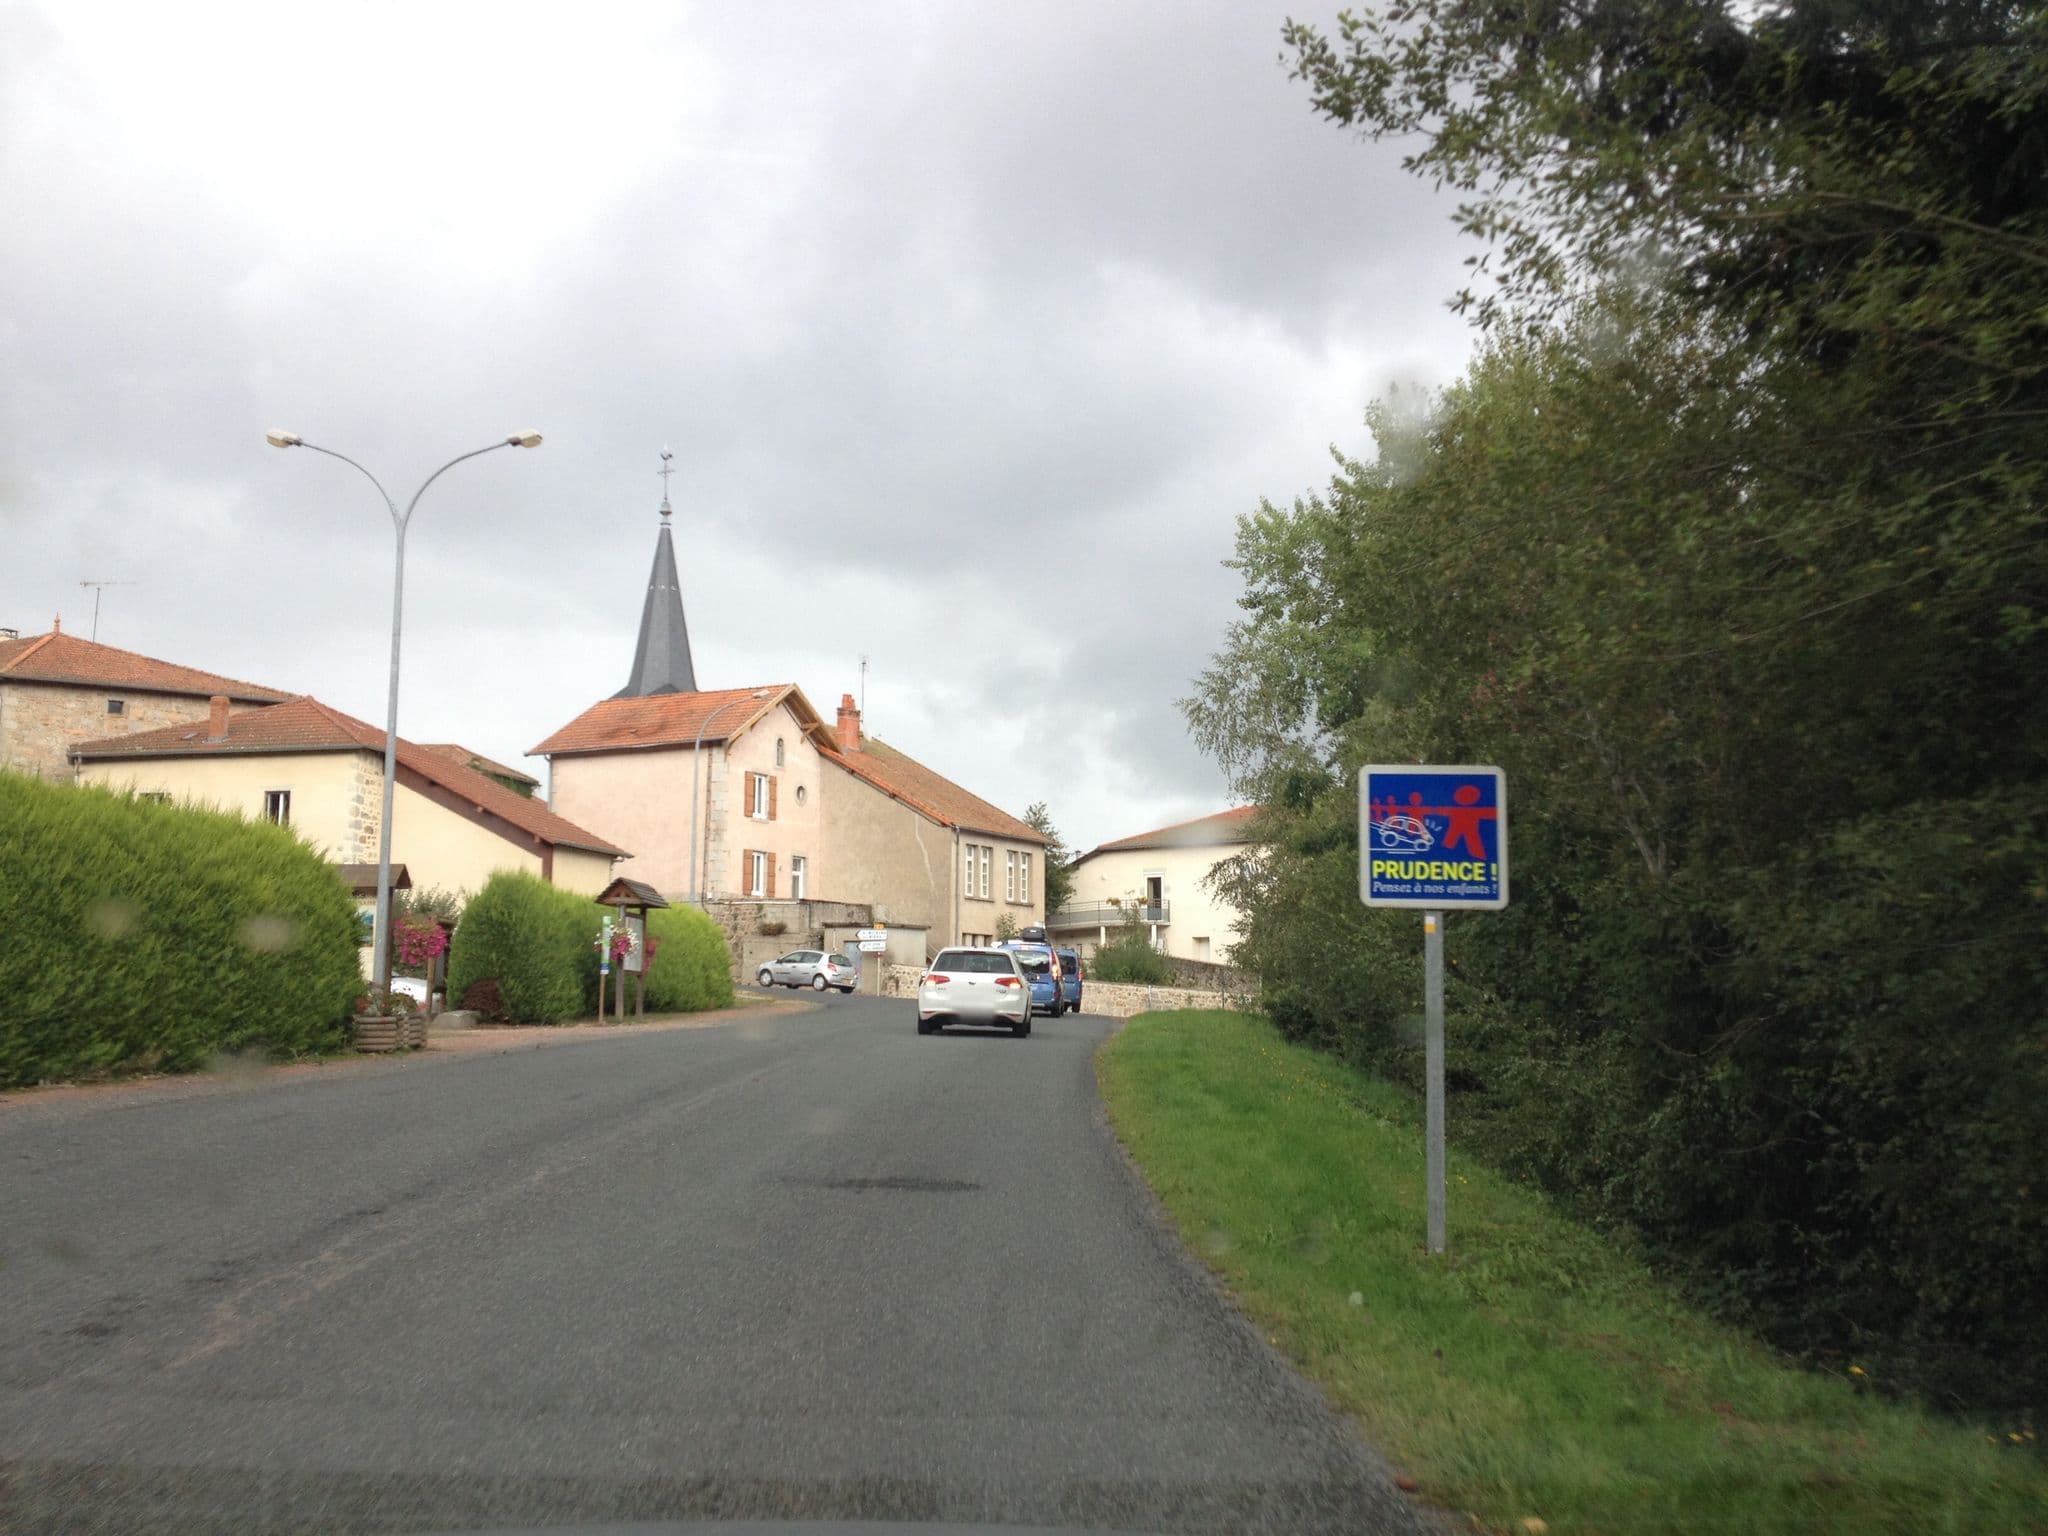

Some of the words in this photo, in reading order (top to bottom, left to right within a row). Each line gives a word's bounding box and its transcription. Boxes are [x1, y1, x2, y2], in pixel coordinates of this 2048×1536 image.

[1372, 860, 1486, 881] PRUDENCE
[1491, 863, 1498, 881] !
[1373, 881, 1412, 893] Pensez
[1413, 882, 1422, 893] à
[1423, 884, 1445, 893] nos
[1446, 883, 1490, 896] enfants
